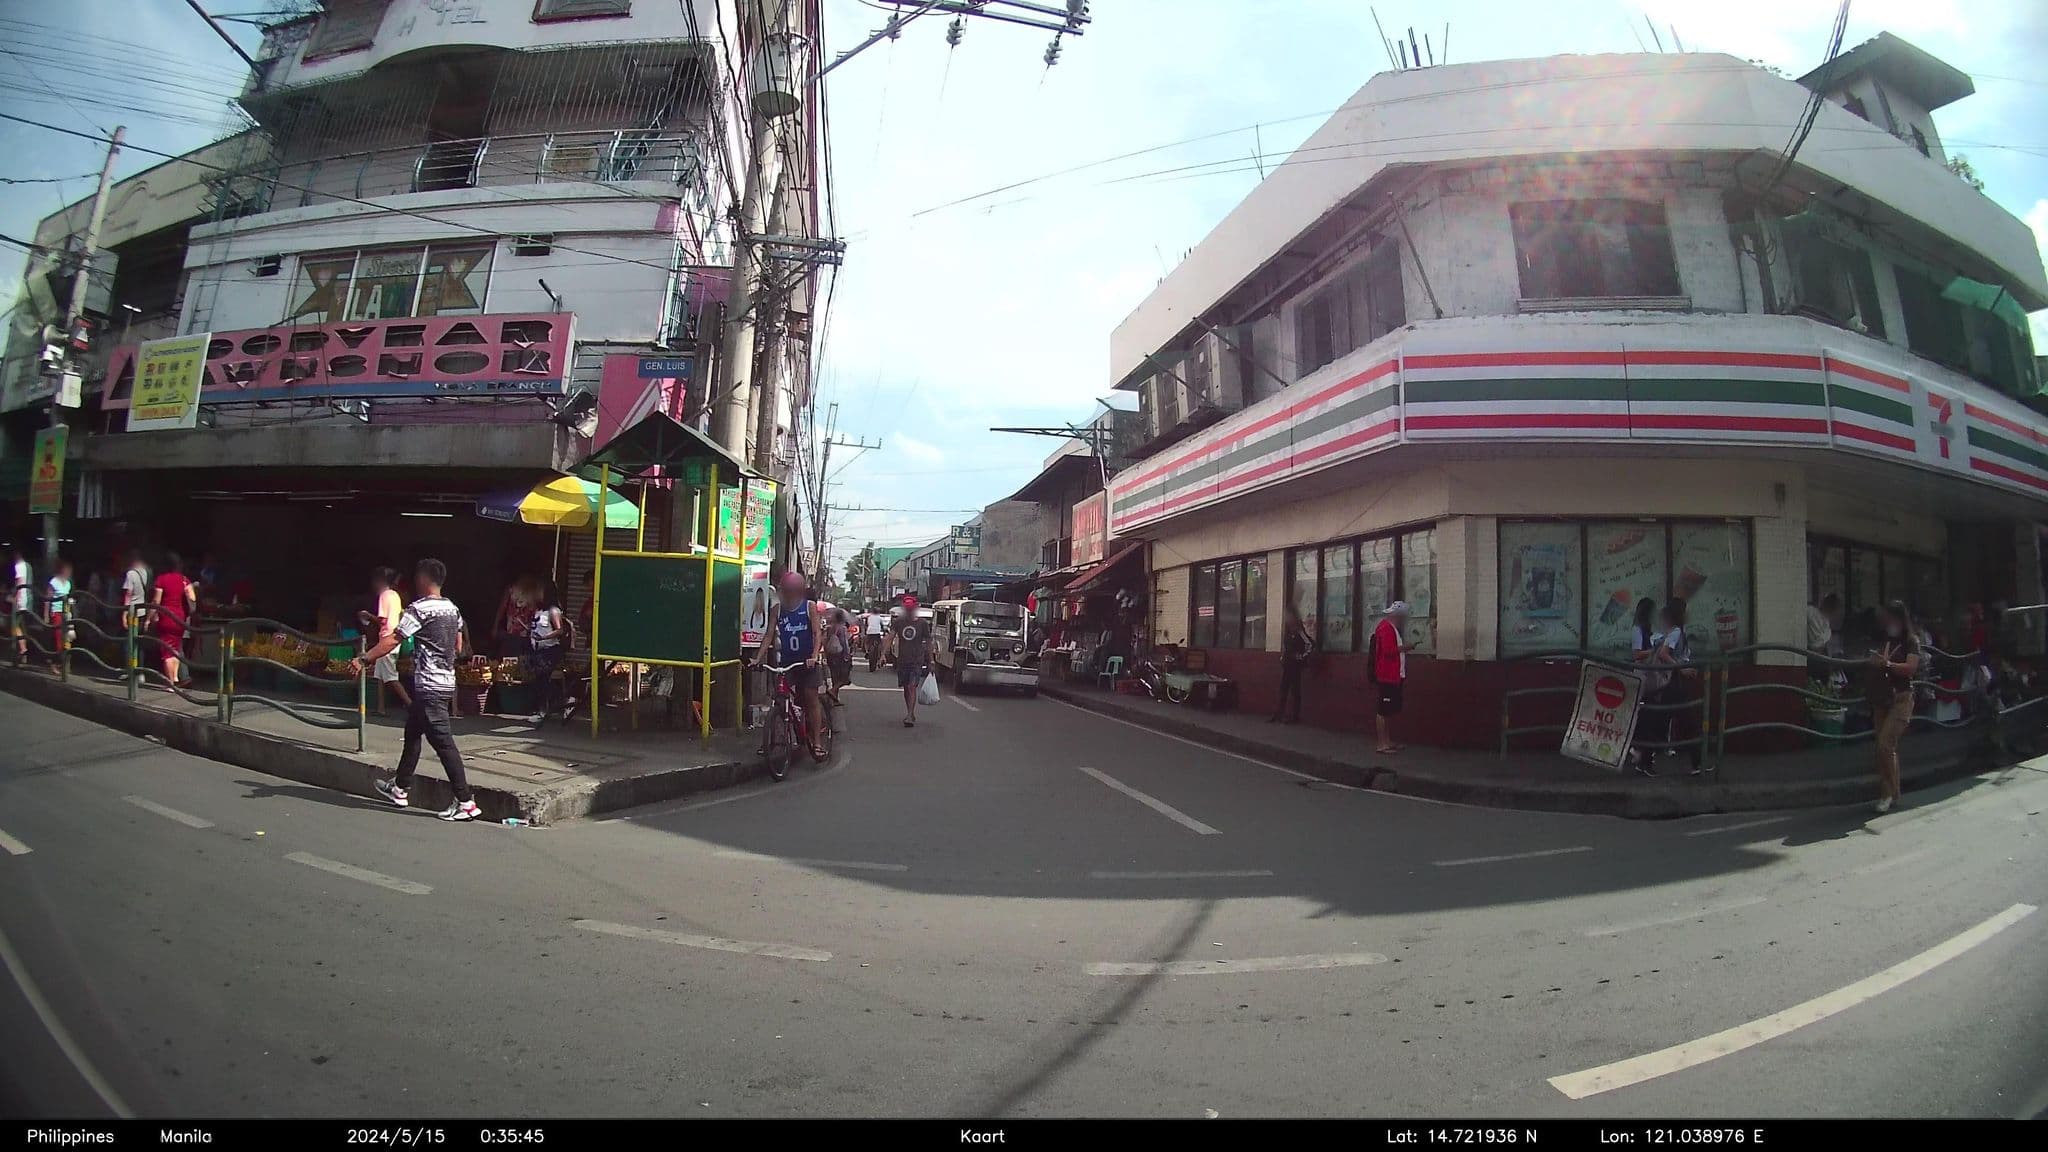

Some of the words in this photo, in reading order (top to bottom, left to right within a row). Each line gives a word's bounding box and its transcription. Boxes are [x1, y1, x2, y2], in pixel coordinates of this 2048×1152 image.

[645, 361, 665, 371] GEN.
[666, 361, 686, 370] LUIS
[486, 381, 553, 391] BRANCH
[789, 635, 800, 652] 0
[1594, 709, 1616, 725] NO
[1576, 719, 1624, 743] ENTRY
